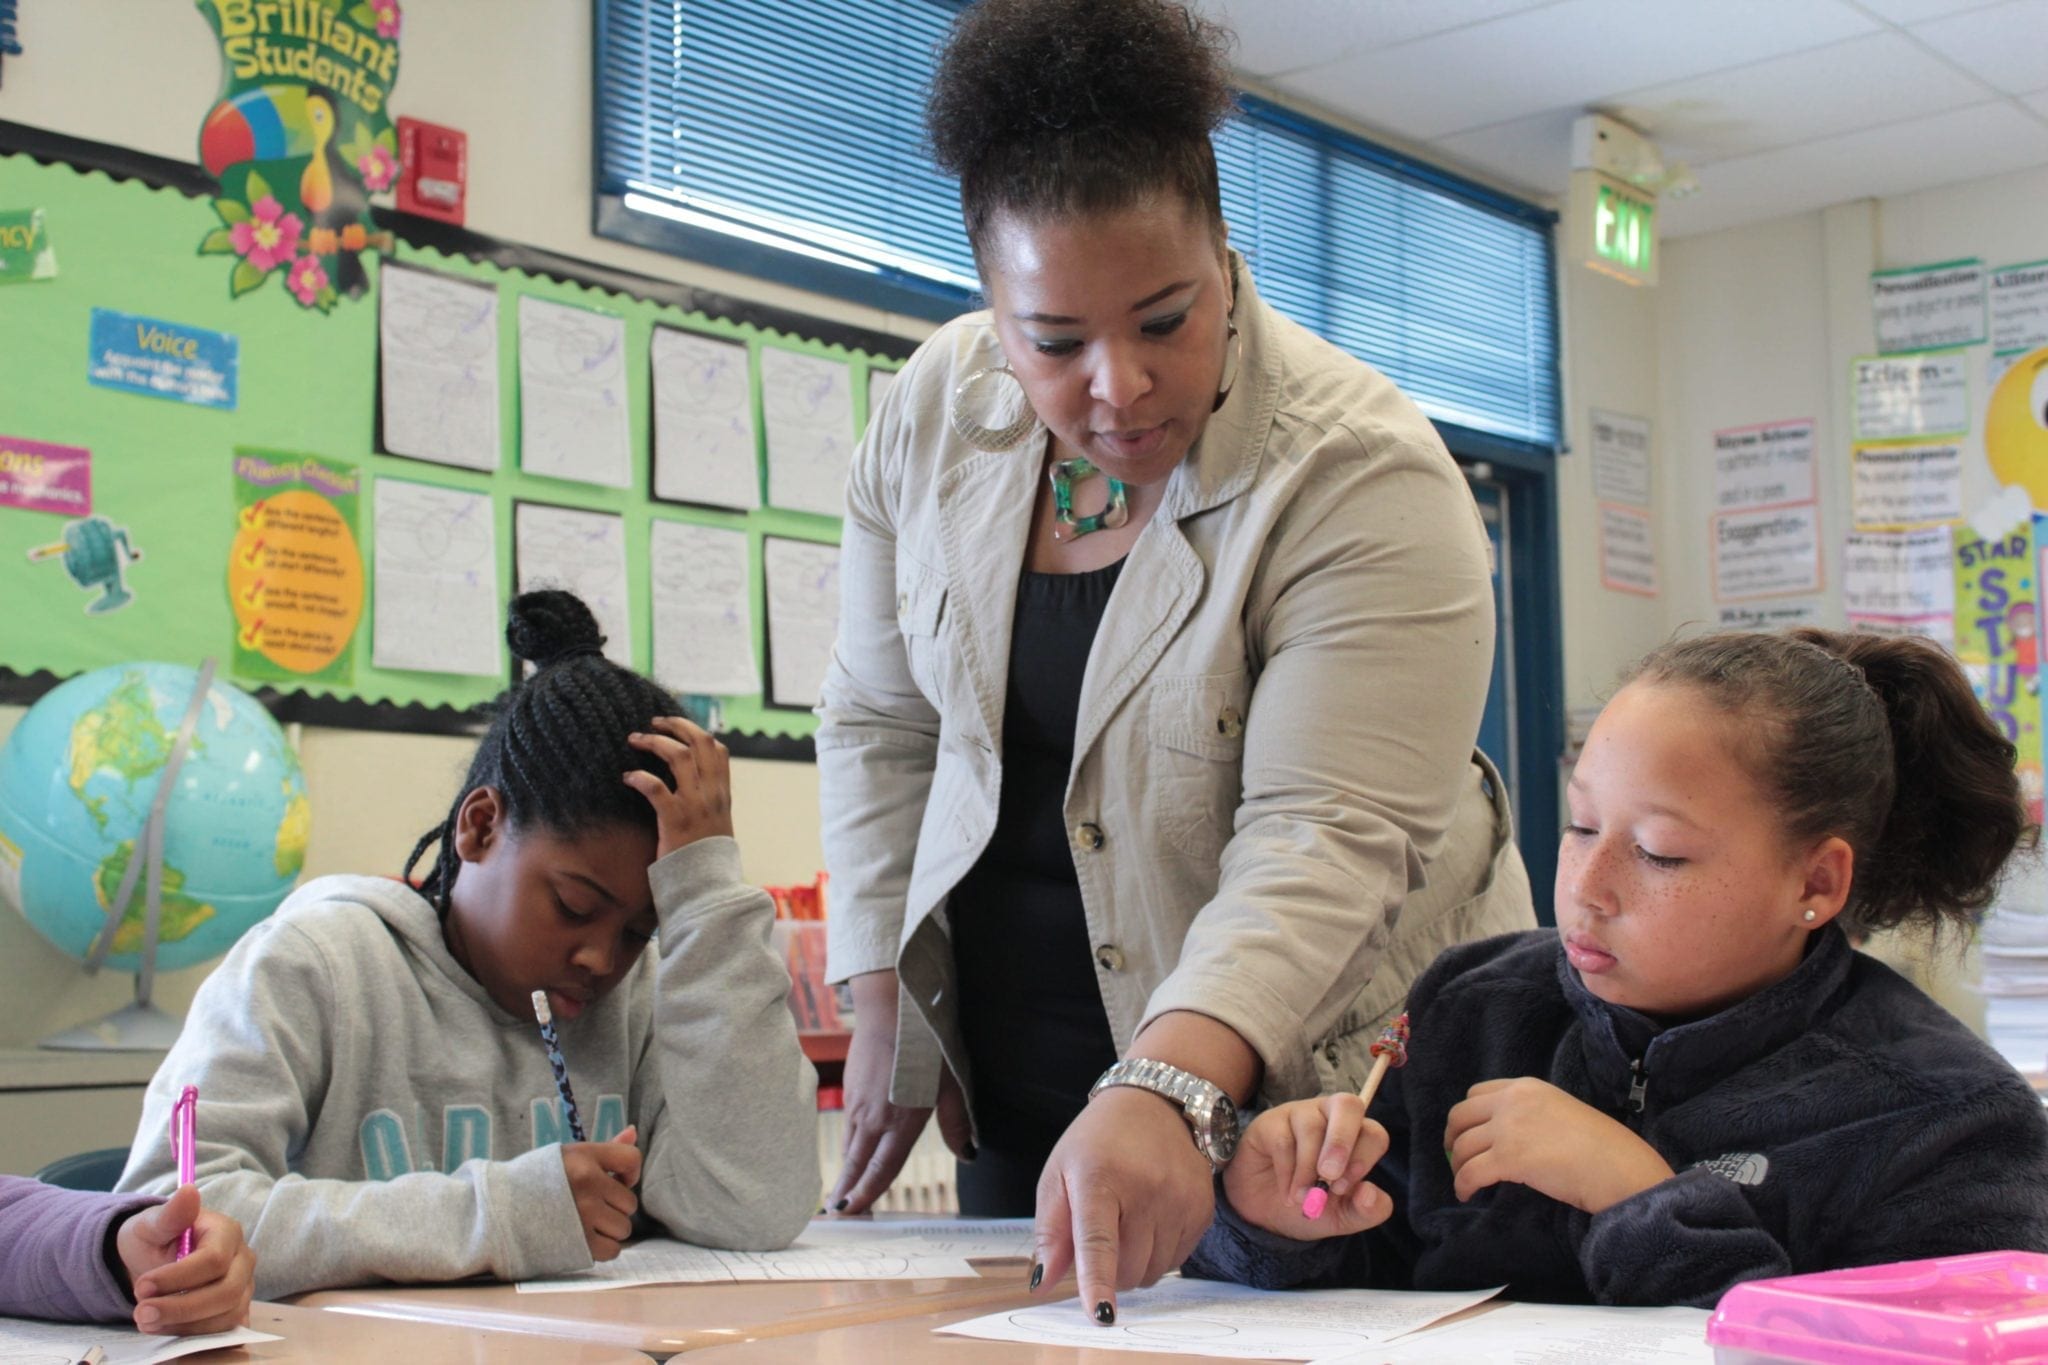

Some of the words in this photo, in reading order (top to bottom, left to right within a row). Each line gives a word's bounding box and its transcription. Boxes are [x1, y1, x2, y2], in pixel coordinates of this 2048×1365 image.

[213, 0, 397, 81] Brilliant
[224, 36, 383, 114] Students
[136, 322, 199, 361] Voice
[1958, 536, 2027, 568] STAR
